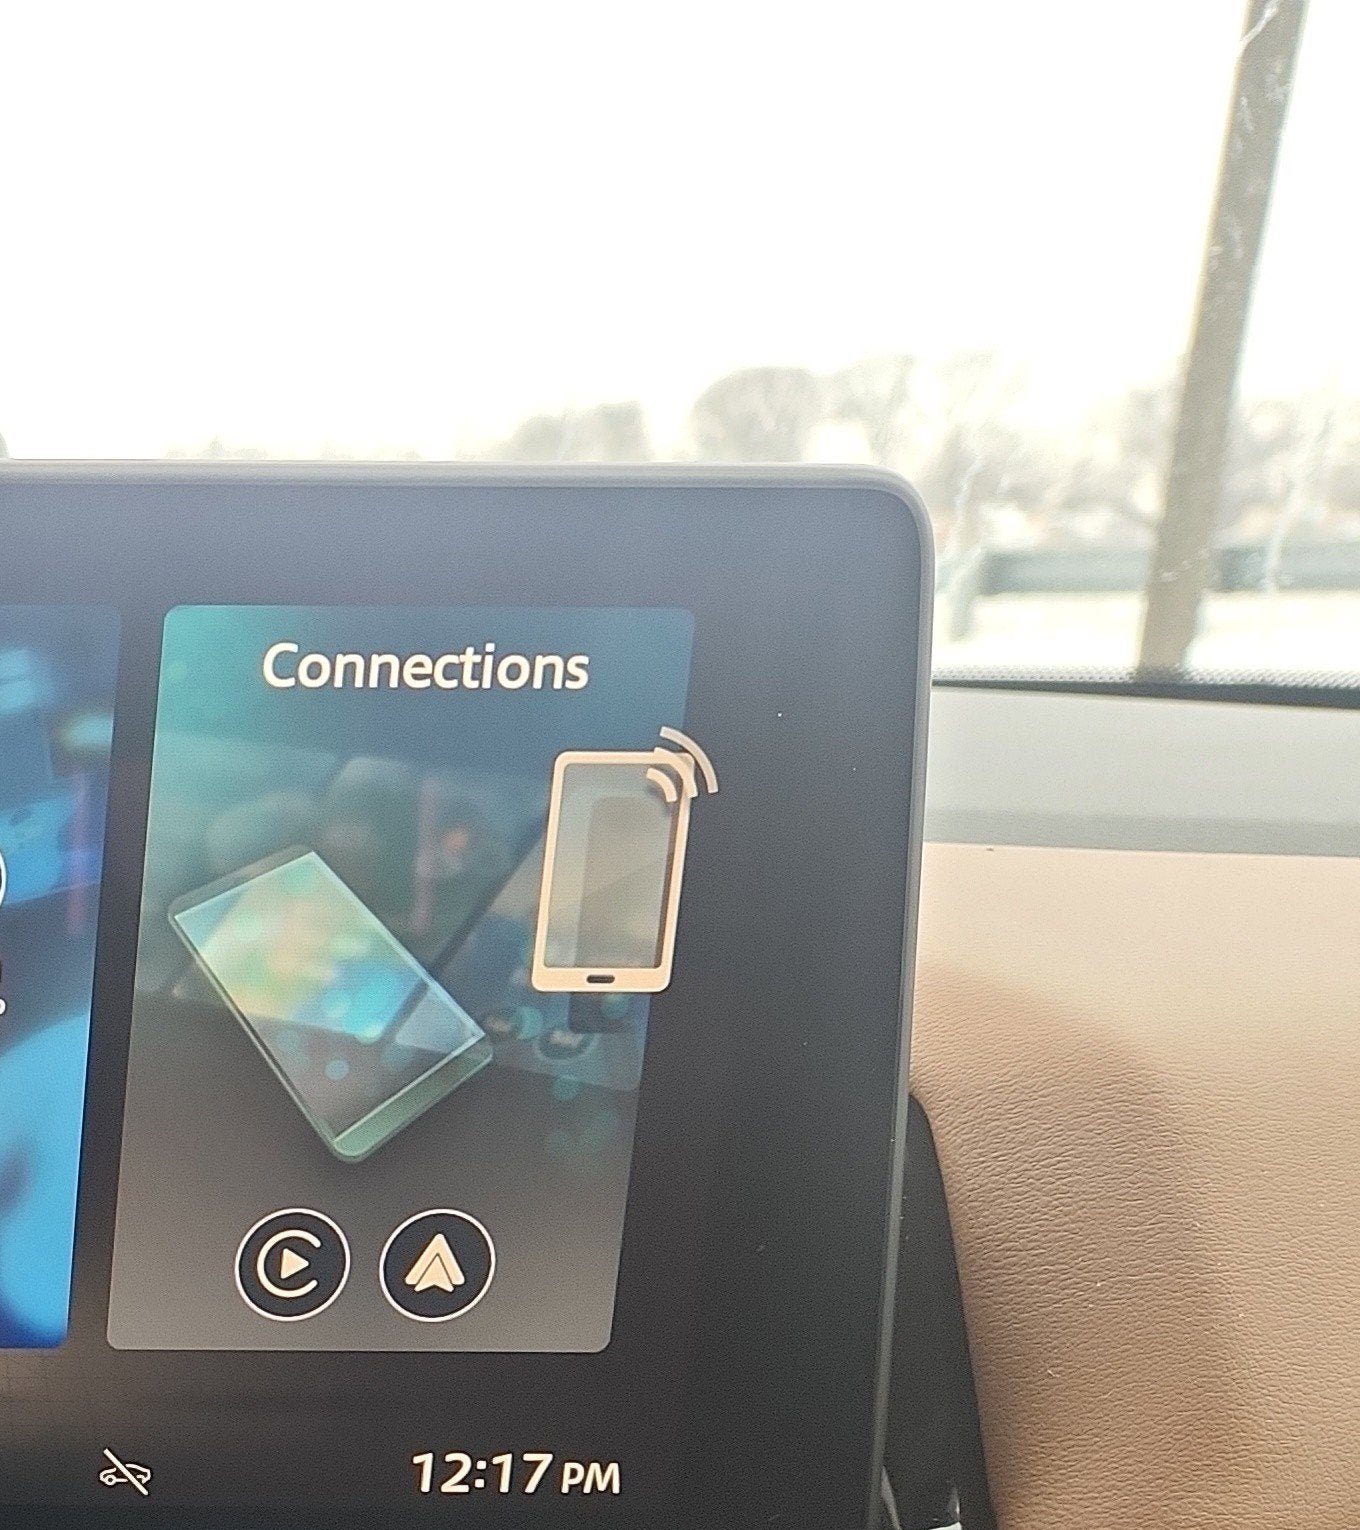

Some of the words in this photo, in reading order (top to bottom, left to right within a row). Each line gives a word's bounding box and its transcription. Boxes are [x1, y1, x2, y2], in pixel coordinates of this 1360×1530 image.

[262, 642, 590, 690] Connections
[412, 1452, 553, 1494] 12:17
[561, 1462, 620, 1494] PM
